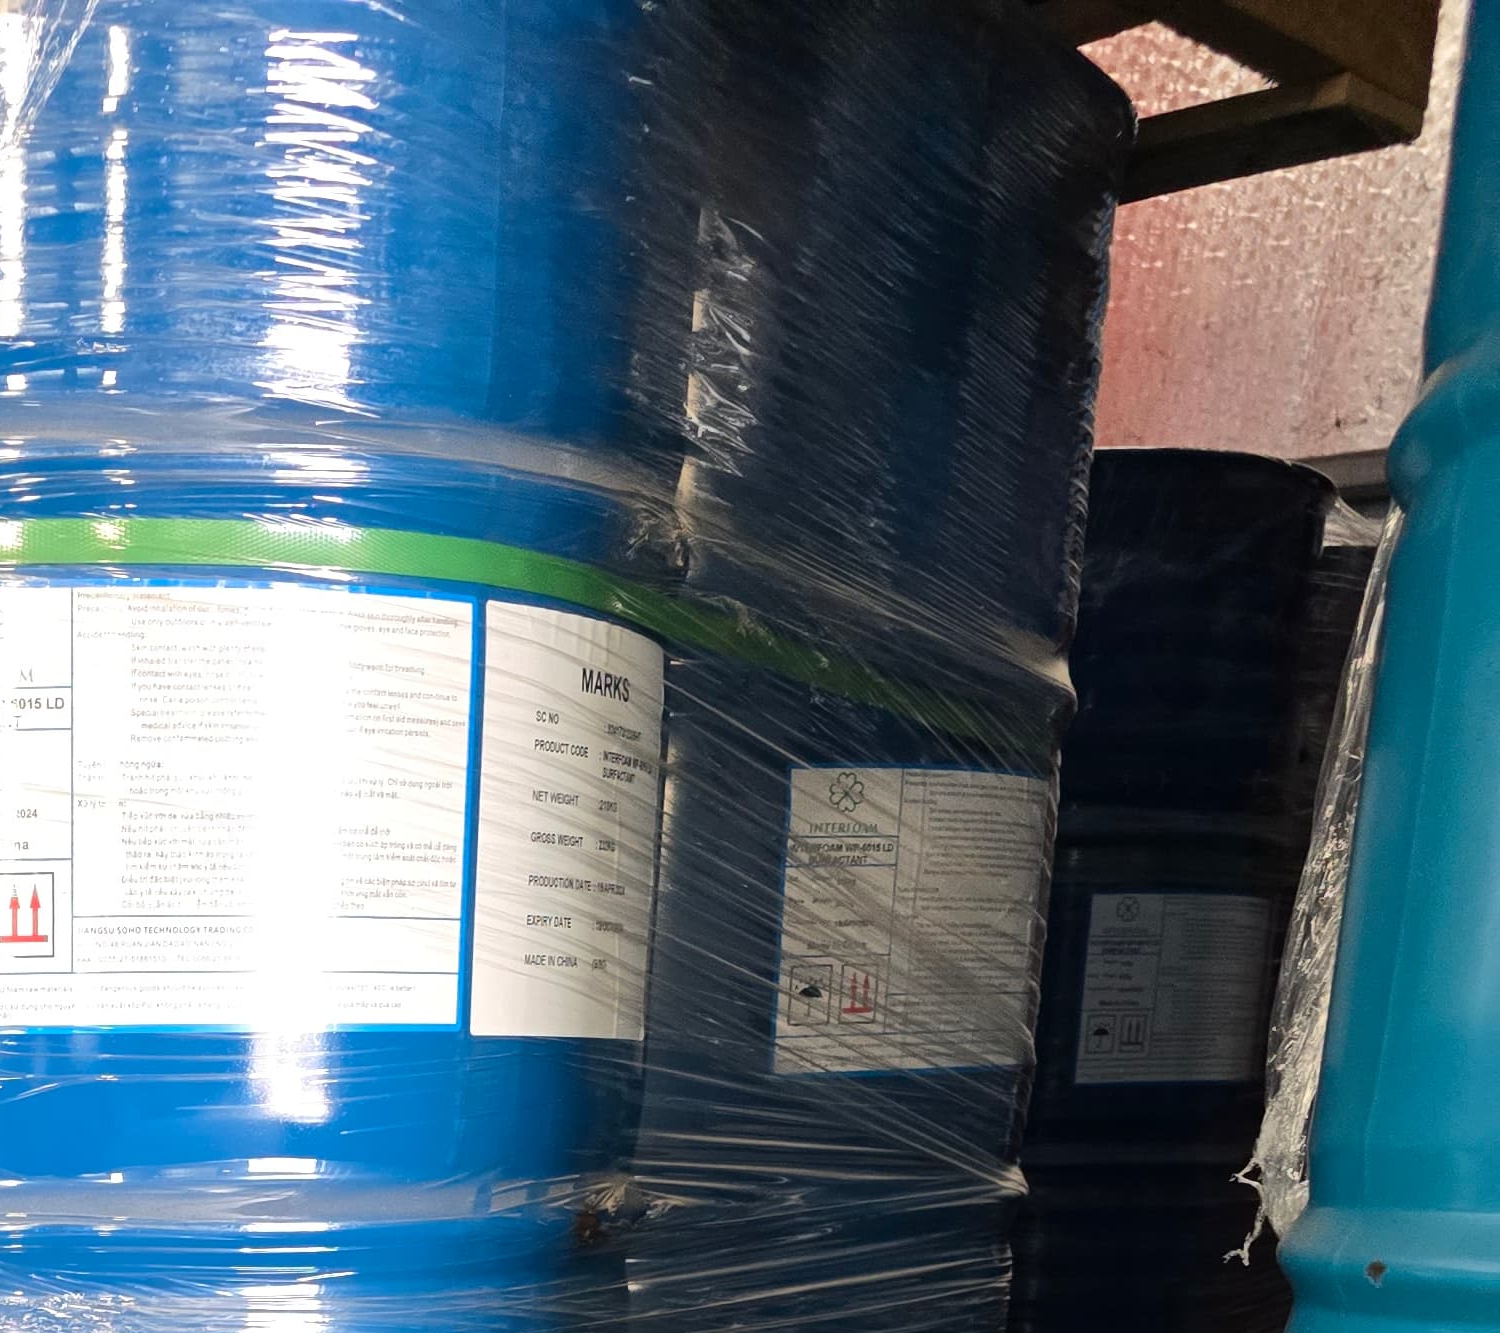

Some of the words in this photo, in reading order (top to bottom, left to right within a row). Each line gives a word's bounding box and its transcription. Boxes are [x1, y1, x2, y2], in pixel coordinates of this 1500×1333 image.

[581, 667, 630, 703] MARKS
[46, 697, 65, 710] LD
[536, 710, 547, 723] SC
[549, 712, 560, 725] NO
[534, 738, 569, 756] PRODUCT
[570, 744, 589, 759] CODE
[532, 789, 549, 802] NET
[550, 790, 580, 807] WEIGHT
[530, 831, 557, 845] GROSS
[557, 833, 584, 848] WEIGHT
[528, 874, 574, 891] PRODUCTION
[575, 878, 592, 892] DATE
[526, 914, 553, 929] EXPIRY
[553, 915, 573, 929] DATE
[524, 953, 547, 967] MADE
[556, 955, 579, 969] CHINA
